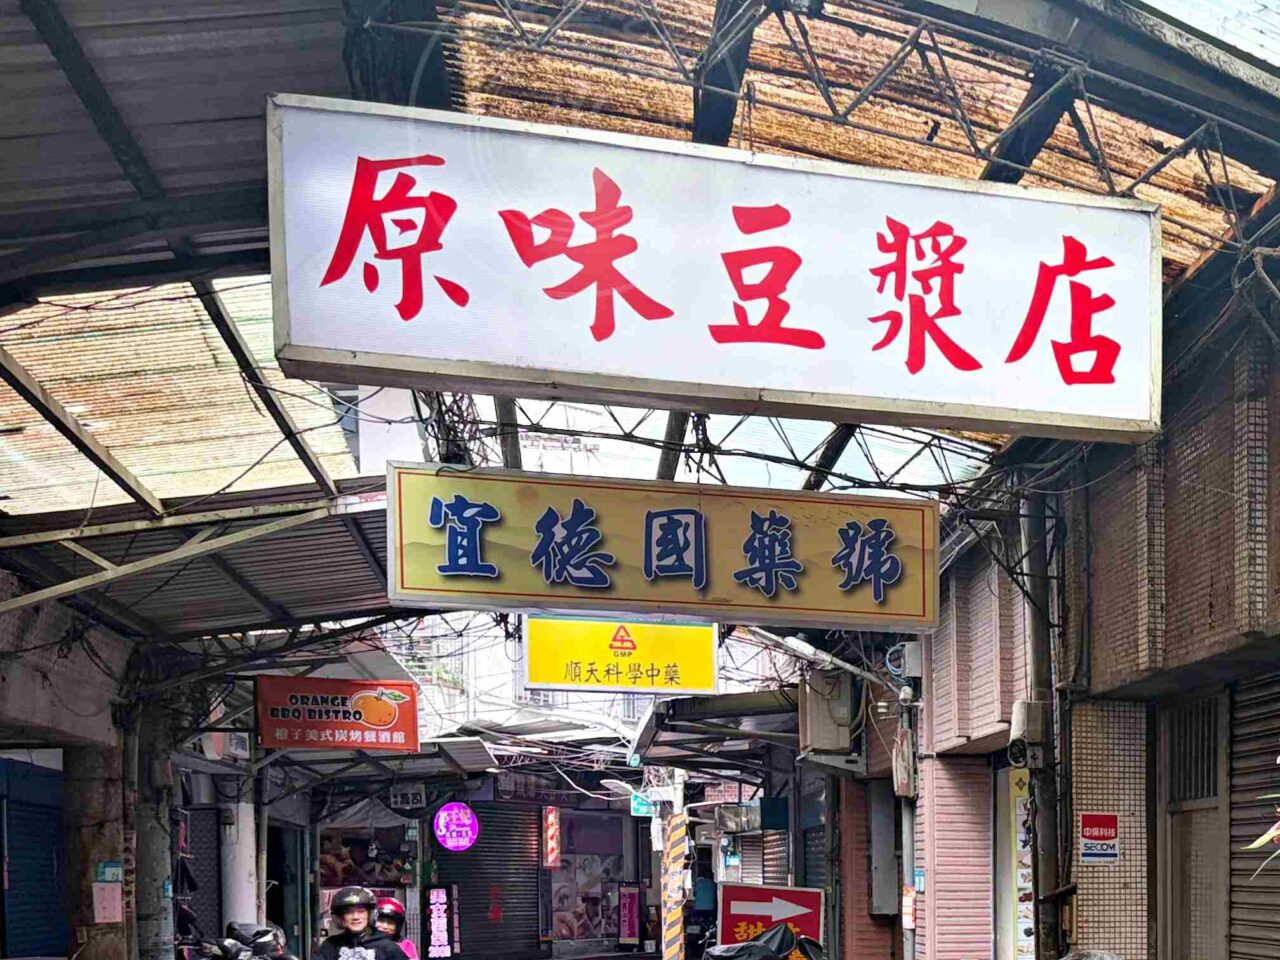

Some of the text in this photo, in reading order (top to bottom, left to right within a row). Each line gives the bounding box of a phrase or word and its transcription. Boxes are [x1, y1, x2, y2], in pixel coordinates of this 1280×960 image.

[320, 154, 1123, 386] 原味豆漿店
[429, 494, 903, 604] 宜德國藥號
[564, 660, 681, 686] 順天科學中藥
[289, 695, 348, 707] ORANGE
[270, 708, 363, 721] BBQ BISTRO
[1083, 843, 1116, 851] SECOM
